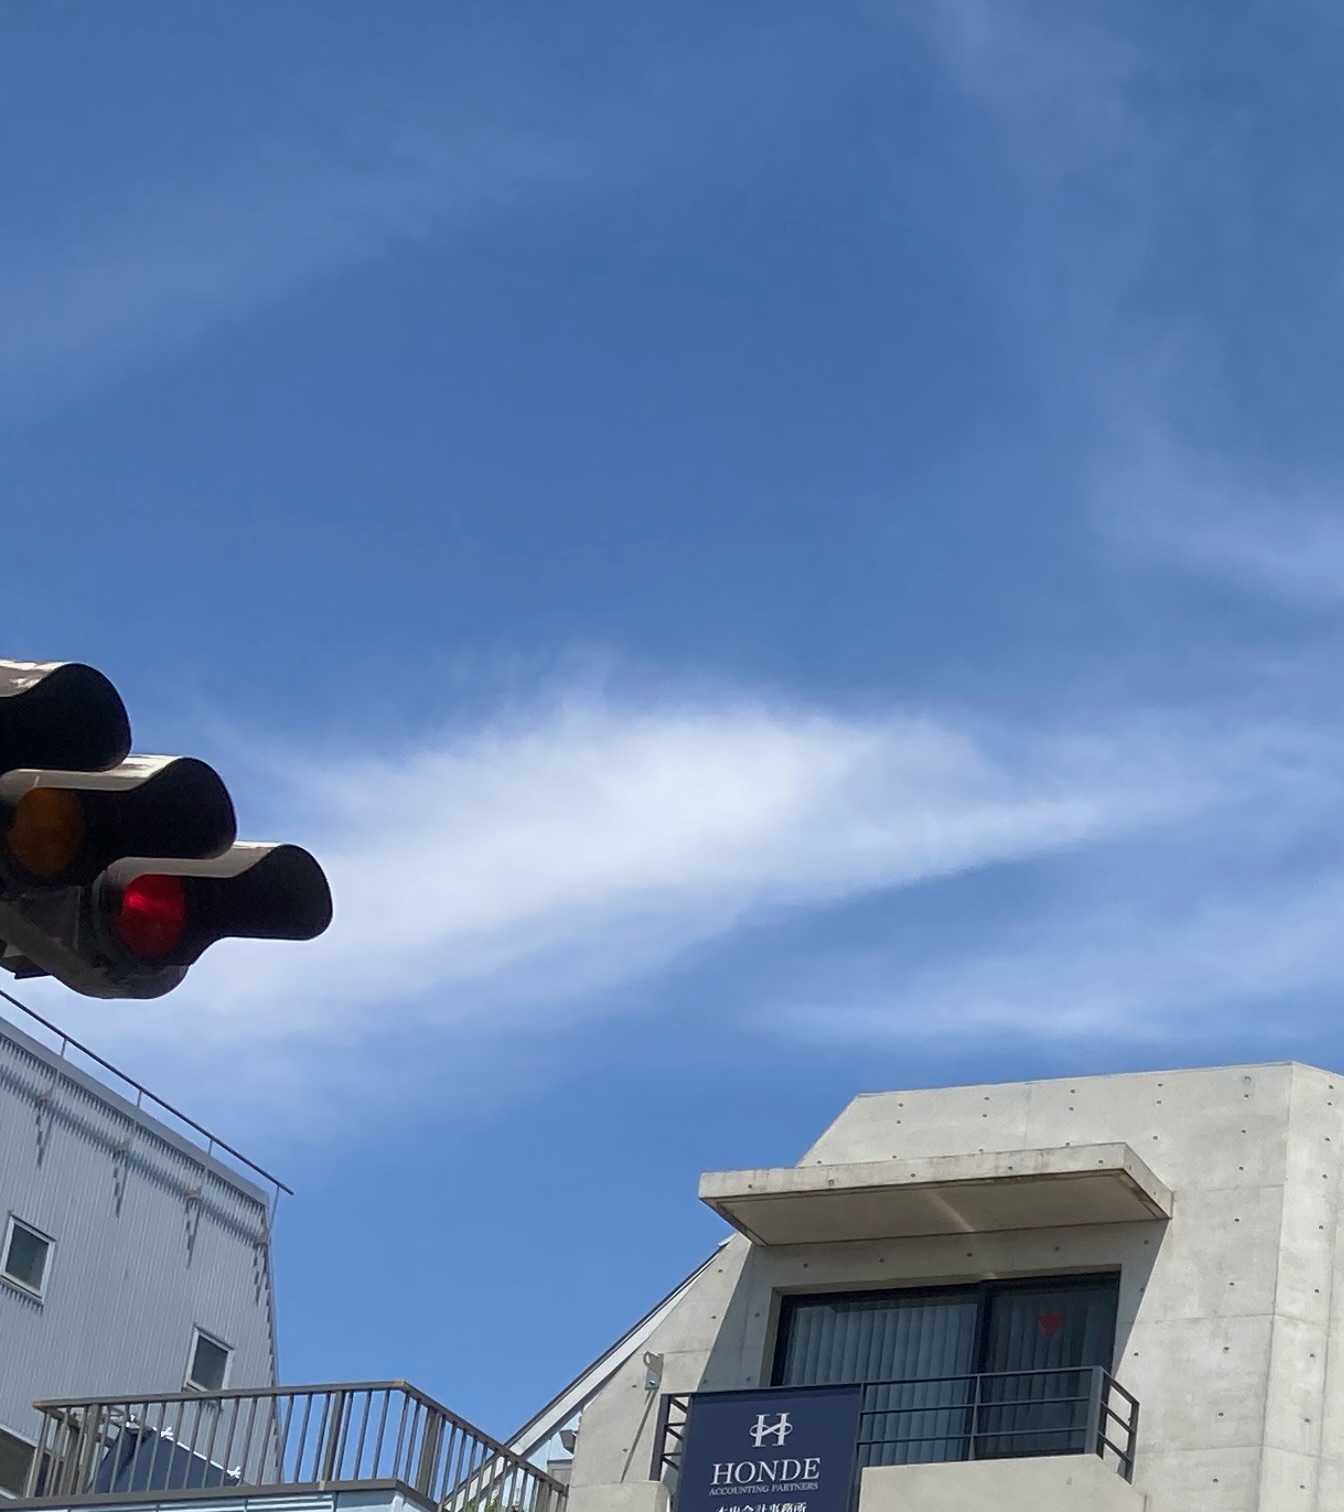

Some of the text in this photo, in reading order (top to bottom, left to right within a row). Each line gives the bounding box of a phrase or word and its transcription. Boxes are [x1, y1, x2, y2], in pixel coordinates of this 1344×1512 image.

[710, 1457, 821, 1485] HONDE
[708, 1481, 819, 1496] ACCOUNTING PARTNERS
